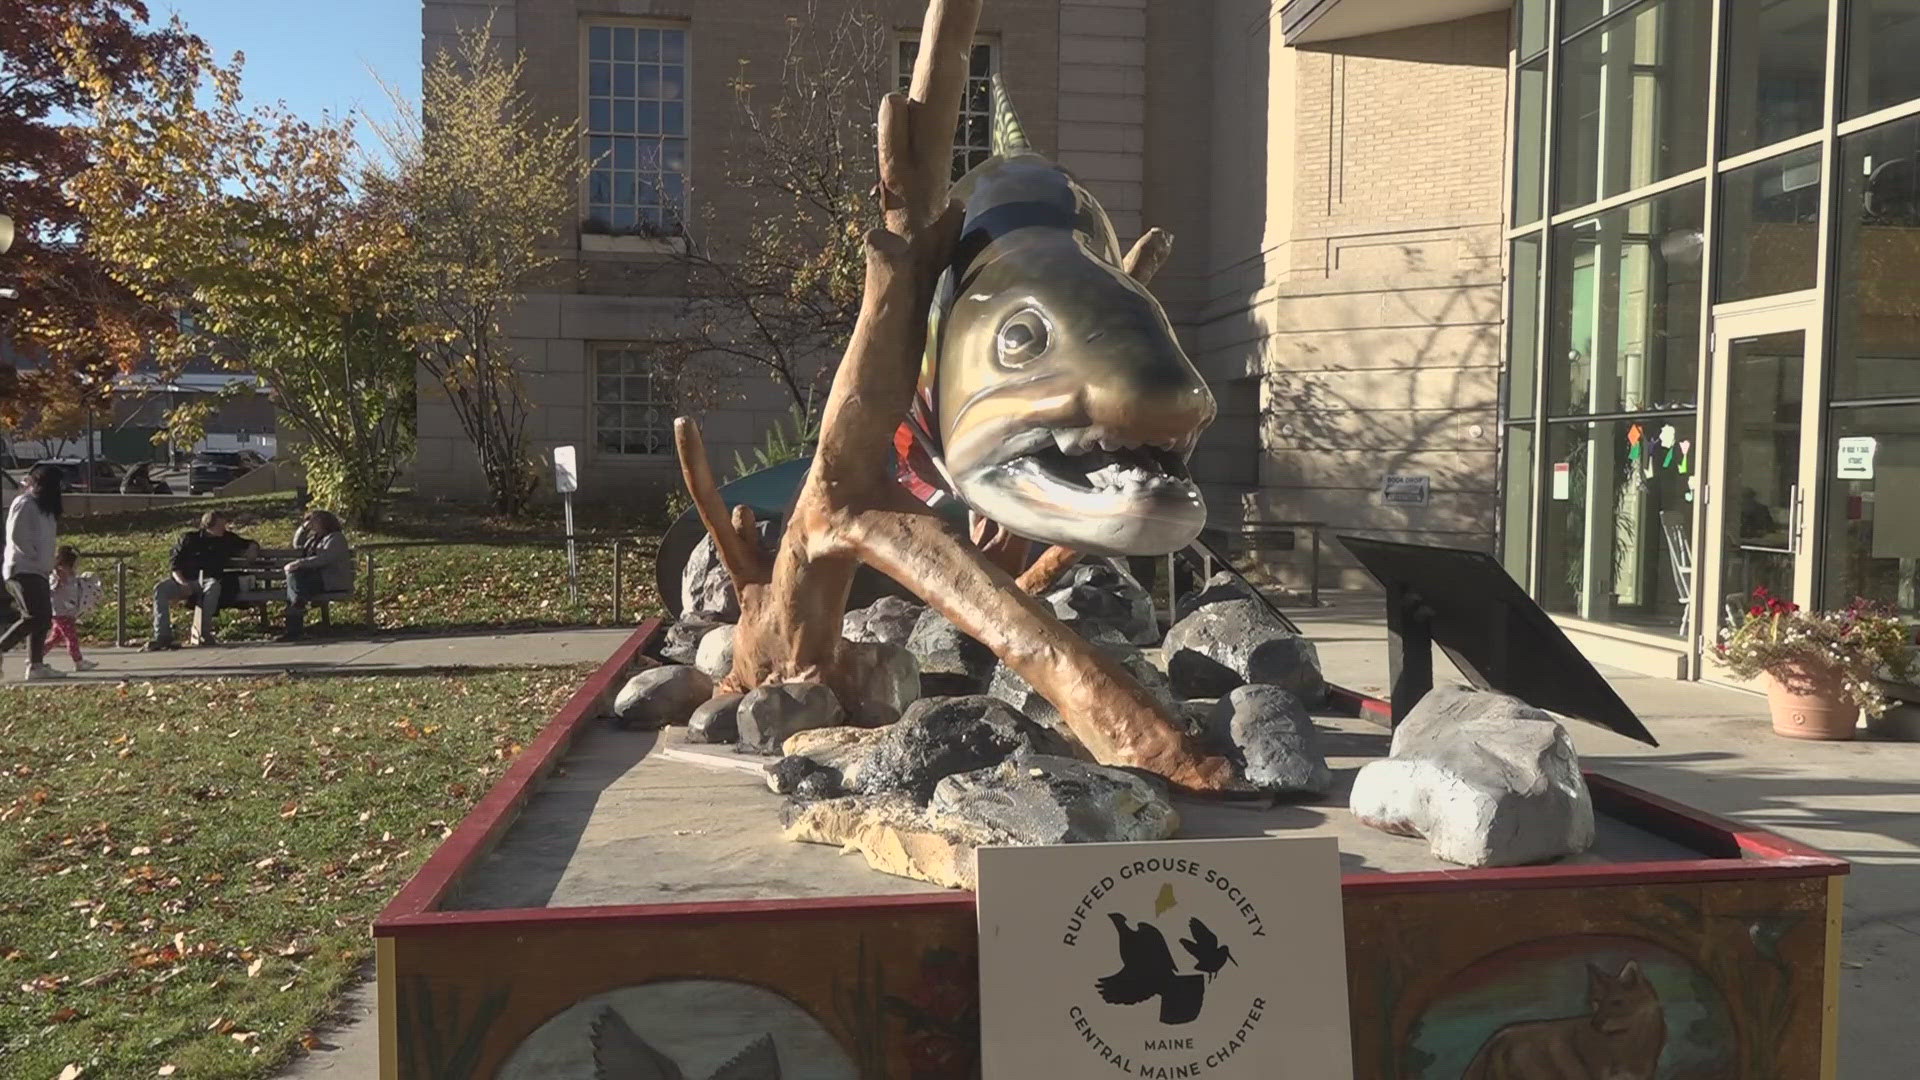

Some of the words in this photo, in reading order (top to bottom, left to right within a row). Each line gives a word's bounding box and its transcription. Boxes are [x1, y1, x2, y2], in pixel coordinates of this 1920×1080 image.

[1063, 876, 1115, 947] RUFFED
[1119, 857, 1200, 880] GROUSE
[1204, 869, 1266, 939] SOCIETY
[1069, 1005, 1132, 1074] CENTRAL
[1139, 1062, 1201, 1080] MAINE
[1205, 996, 1266, 1069] CHAPTER
[1144, 1037, 1194, 1051] MAINE
